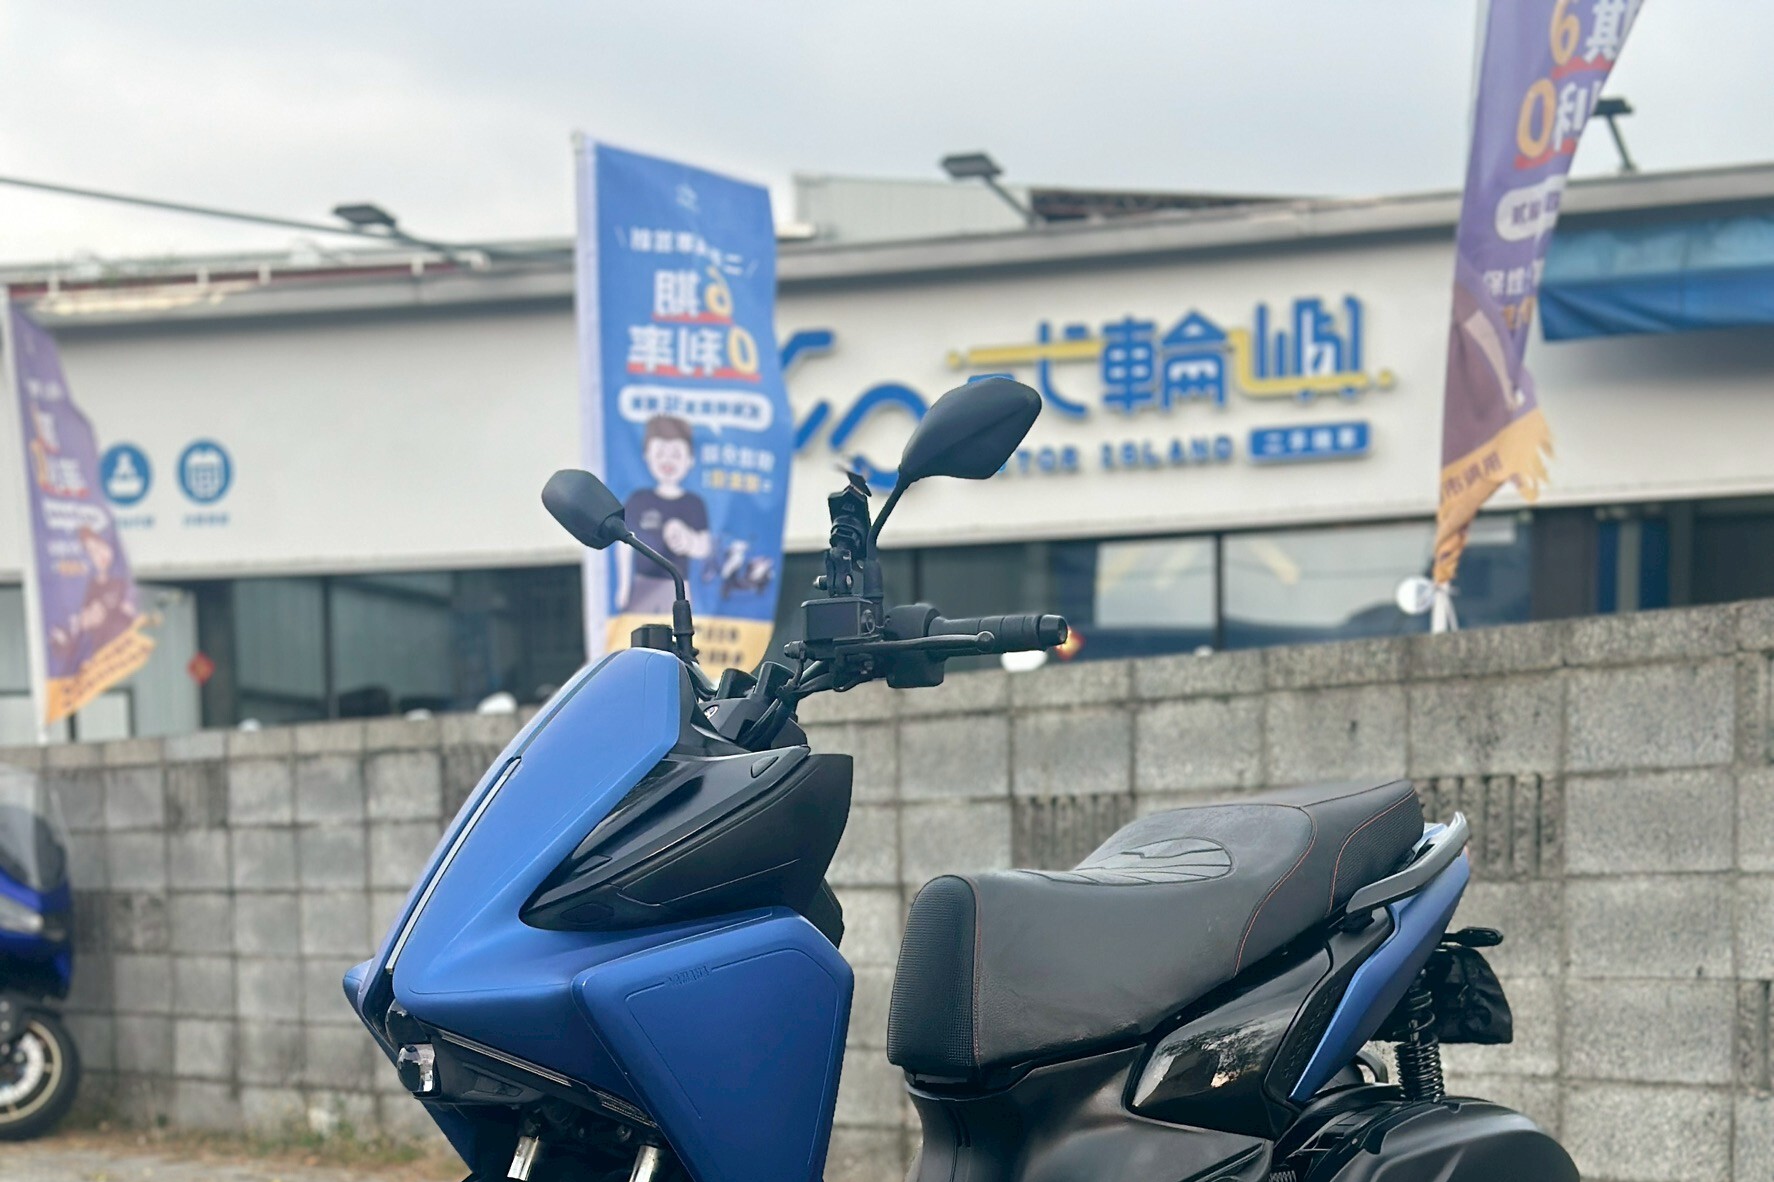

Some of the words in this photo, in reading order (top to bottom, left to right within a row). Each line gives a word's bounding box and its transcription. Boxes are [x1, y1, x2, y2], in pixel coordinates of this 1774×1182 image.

[1516, 78, 1598, 154] 0利
[1000, 447, 1080, 474] TOR
[1101, 436, 1235, 469] ISLAND
